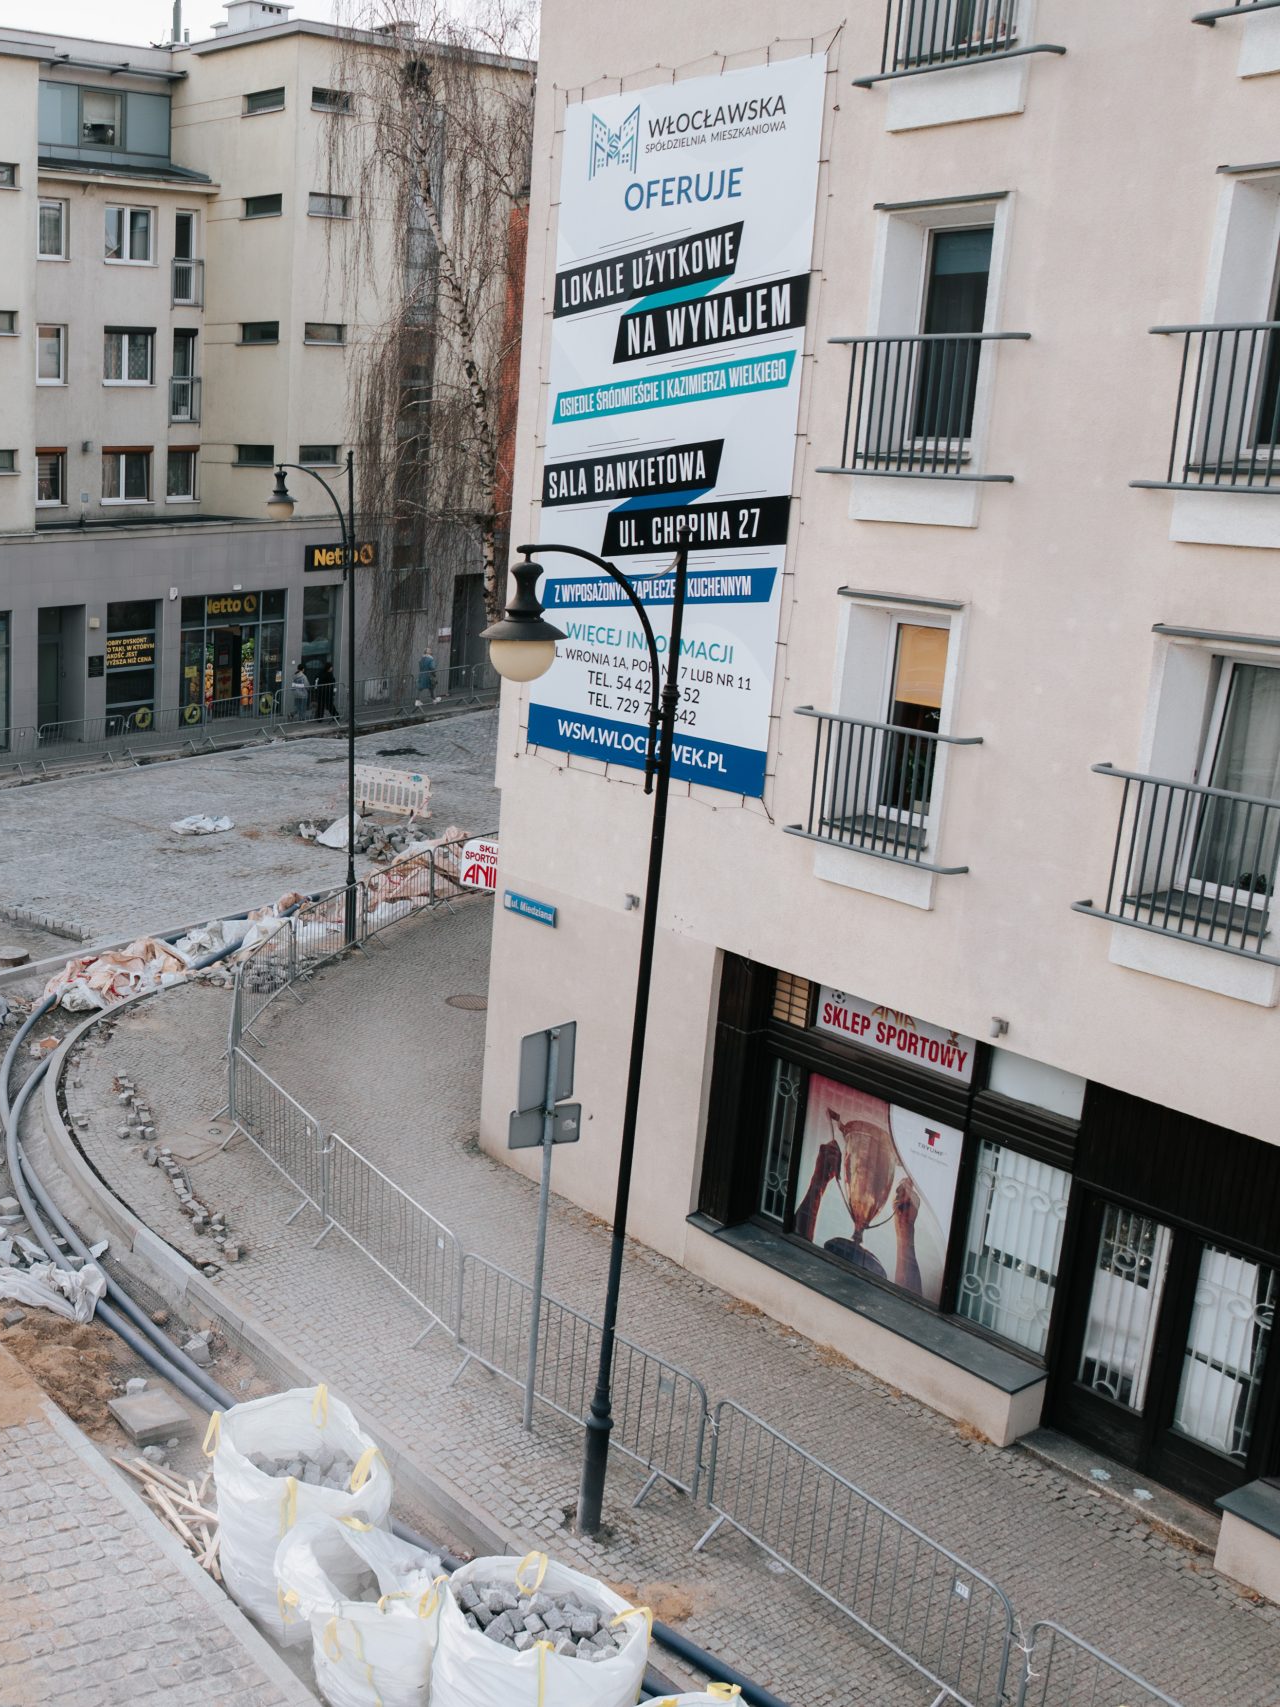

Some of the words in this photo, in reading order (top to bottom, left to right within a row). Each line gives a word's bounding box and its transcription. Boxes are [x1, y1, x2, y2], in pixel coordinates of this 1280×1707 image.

[645, 134, 707, 154] SPÓŁDZIELNIA
[710, 120, 787, 143] MIESZKANIOWA
[648, 95, 786, 138] WŁOCŁAWSKA
[624, 167, 744, 211] OFERUJE
[561, 262, 624, 308] LOKALE
[632, 231, 735, 289] UŻYTKOWE
[627, 314, 656, 356] NA
[666, 283, 791, 347] WYNAJEM
[559, 392, 595, 417] OSIEDLE
[596, 380, 659, 411] ŚRÓDMIEŚCIE
[661, 385, 665, 400] I
[666, 369, 727, 399] KAZIMIERZA
[728, 358, 787, 388] WIELKIEGO
[548, 467, 587, 499] SALA
[594, 450, 706, 493] BANKIETOWA
[619, 519, 644, 547] UL.
[652, 511, 731, 545] CHOPINA
[738, 508, 760, 539] 27
[314, 547, 359, 567] Net
[554, 584, 560, 603] Z
[631, 579, 677, 600] ZAPLECZE
[687, 575, 752, 598] KUCHENNYM
[565, 621, 623, 647] WIĘCEJ
[626, 630, 734, 664] INOMACJI
[565, 648, 611, 666] WRONIA
[612, 655, 630, 671] 1A,
[681, 666, 688, 679] 7
[690, 668, 714, 685] LUB
[716, 673, 734, 688] NR
[737, 676, 752, 691] 11
[588, 669, 613, 688] TEL.
[616, 675, 632, 691] 54
[634, 679, 652, 695] 42
[683, 687, 700, 704] 52
[588, 690, 613, 710] TEL.
[616, 696, 640, 714] 729
[465, 850, 498, 866] SPORTO
[479, 843, 499, 855] SKL
[823, 1002, 871, 1036] SKLEP
[875, 1021, 968, 1072] SPORTOWY
[871, 1005, 918, 1032] ANIA
